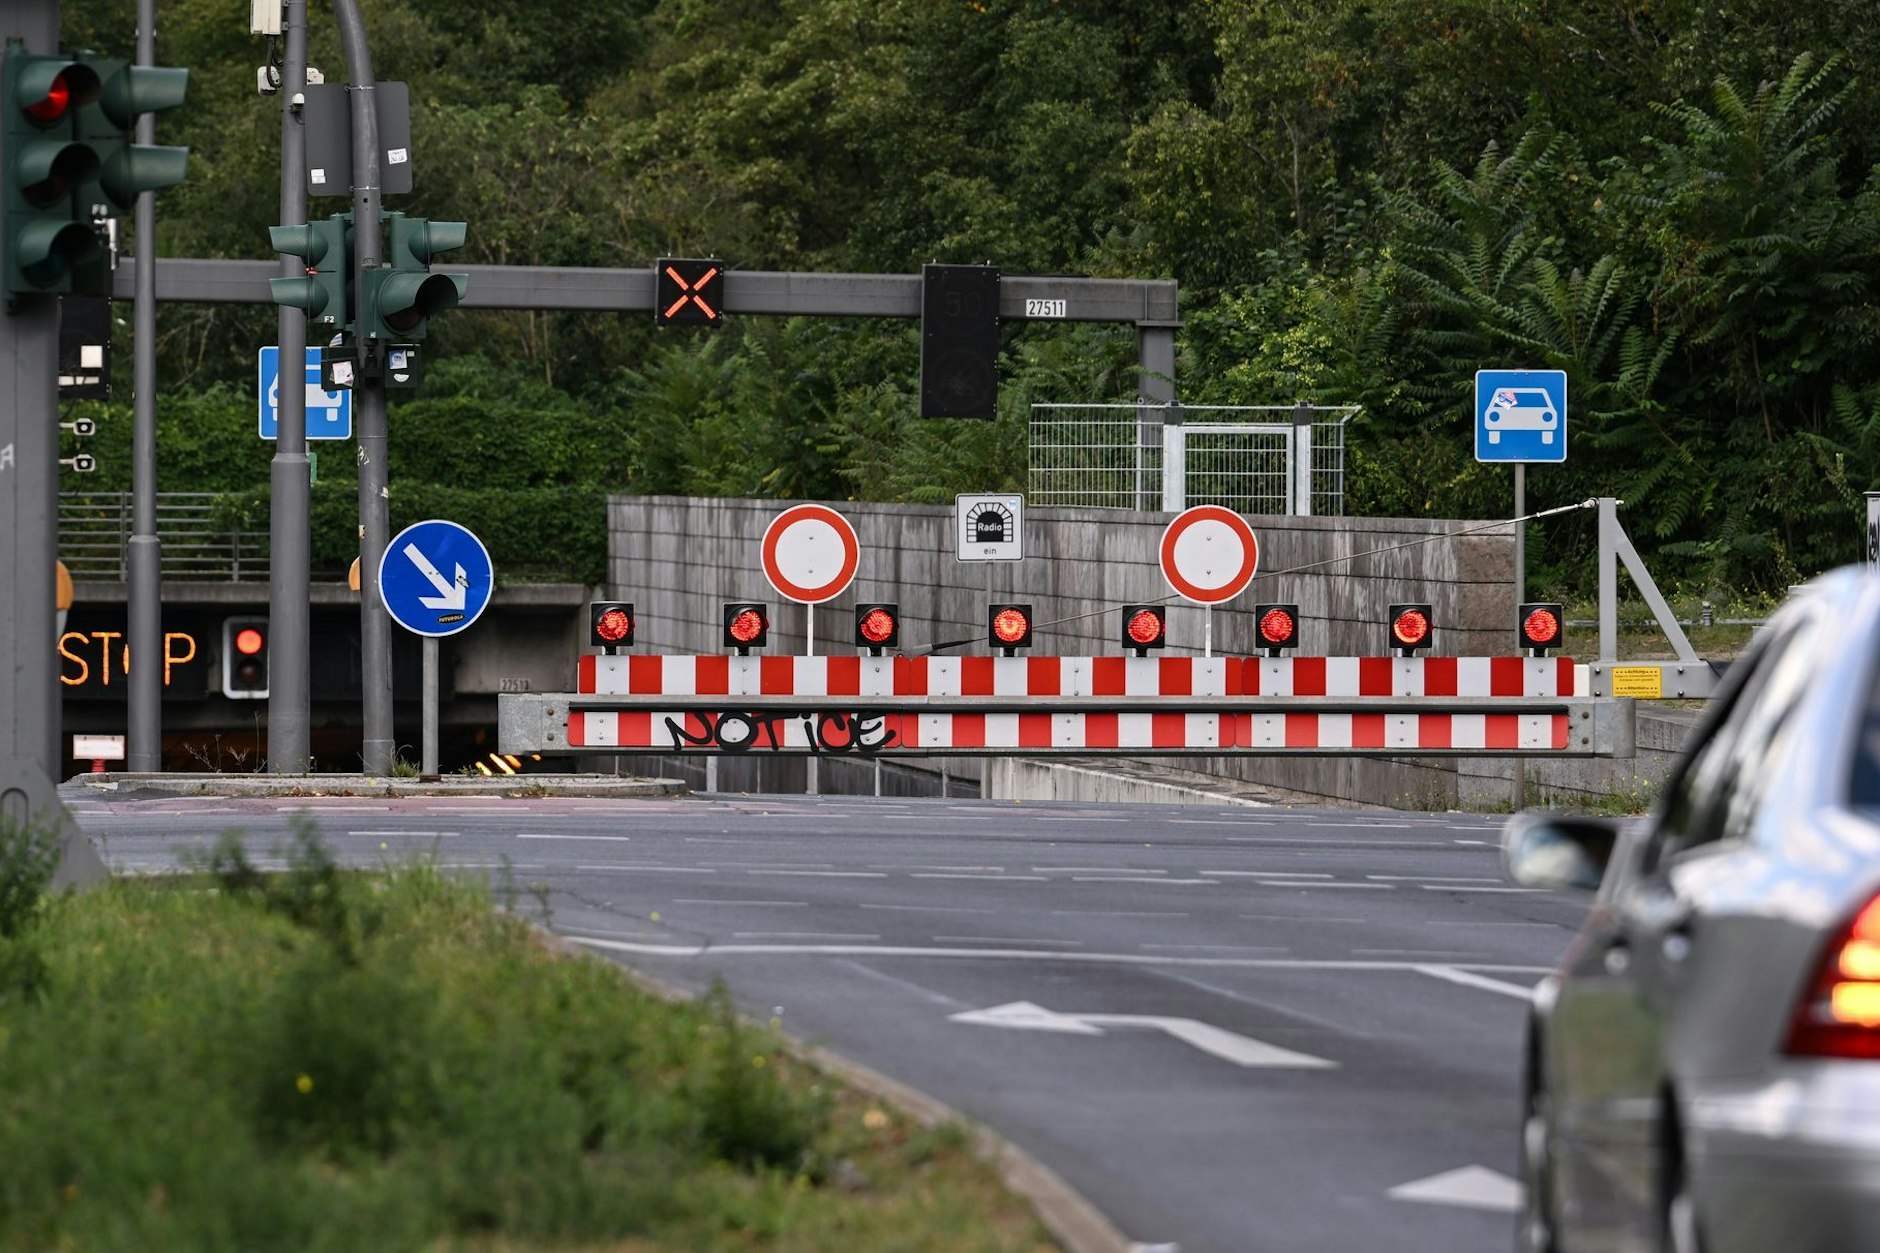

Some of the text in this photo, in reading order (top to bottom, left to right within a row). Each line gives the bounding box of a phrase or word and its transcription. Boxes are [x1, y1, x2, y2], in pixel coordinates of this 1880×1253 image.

[1029, 301, 1063, 316] 27511
[977, 522, 1003, 532] Radio
[57, 632, 197, 686] STP
